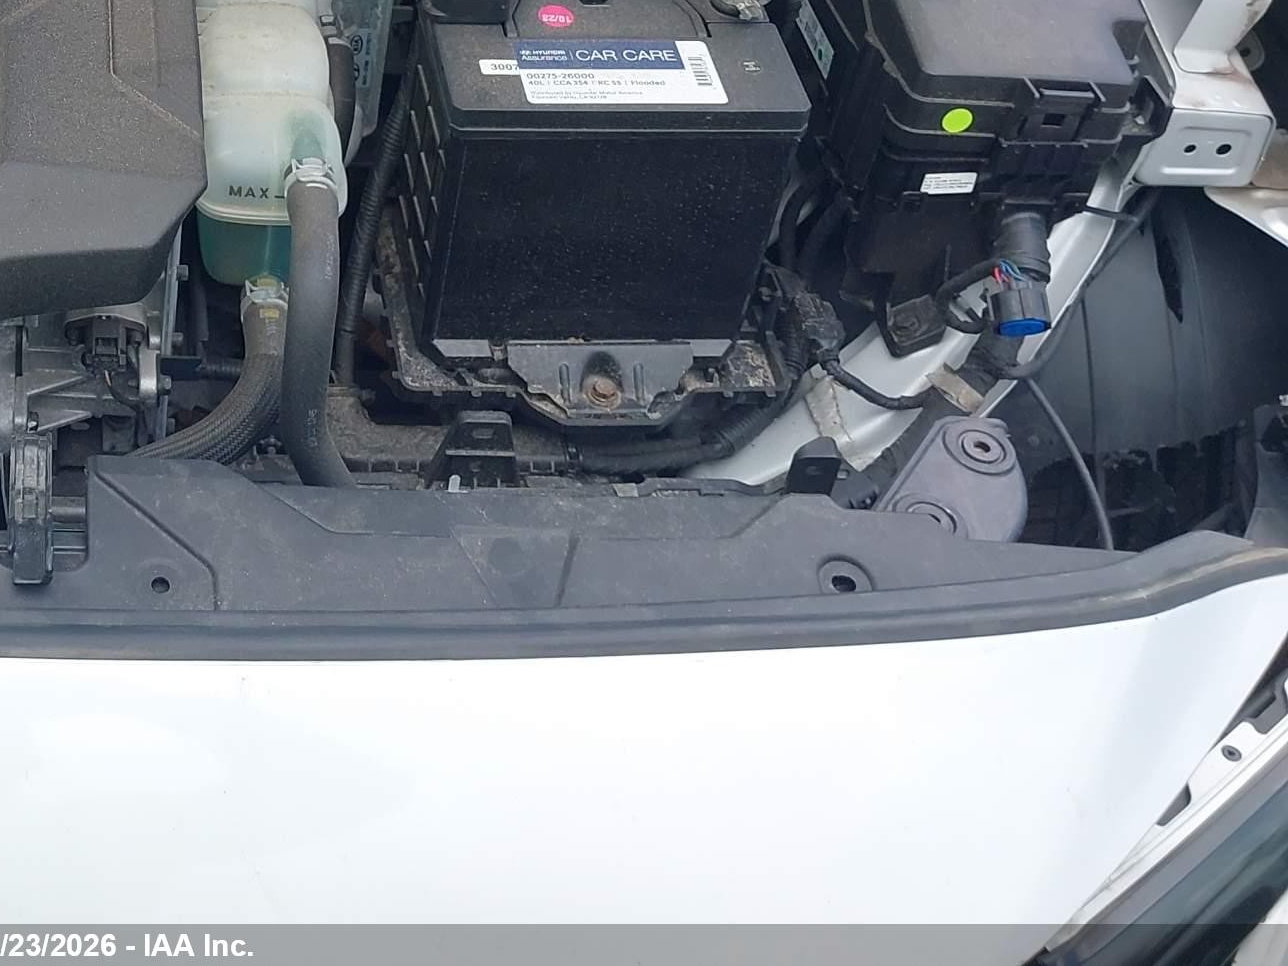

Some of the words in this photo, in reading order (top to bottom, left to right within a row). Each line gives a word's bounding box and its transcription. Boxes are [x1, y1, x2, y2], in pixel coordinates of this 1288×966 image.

[575, 49, 619, 62] CAR
[622, 49, 678, 62] CARE
[228, 185, 270, 199] MAX
